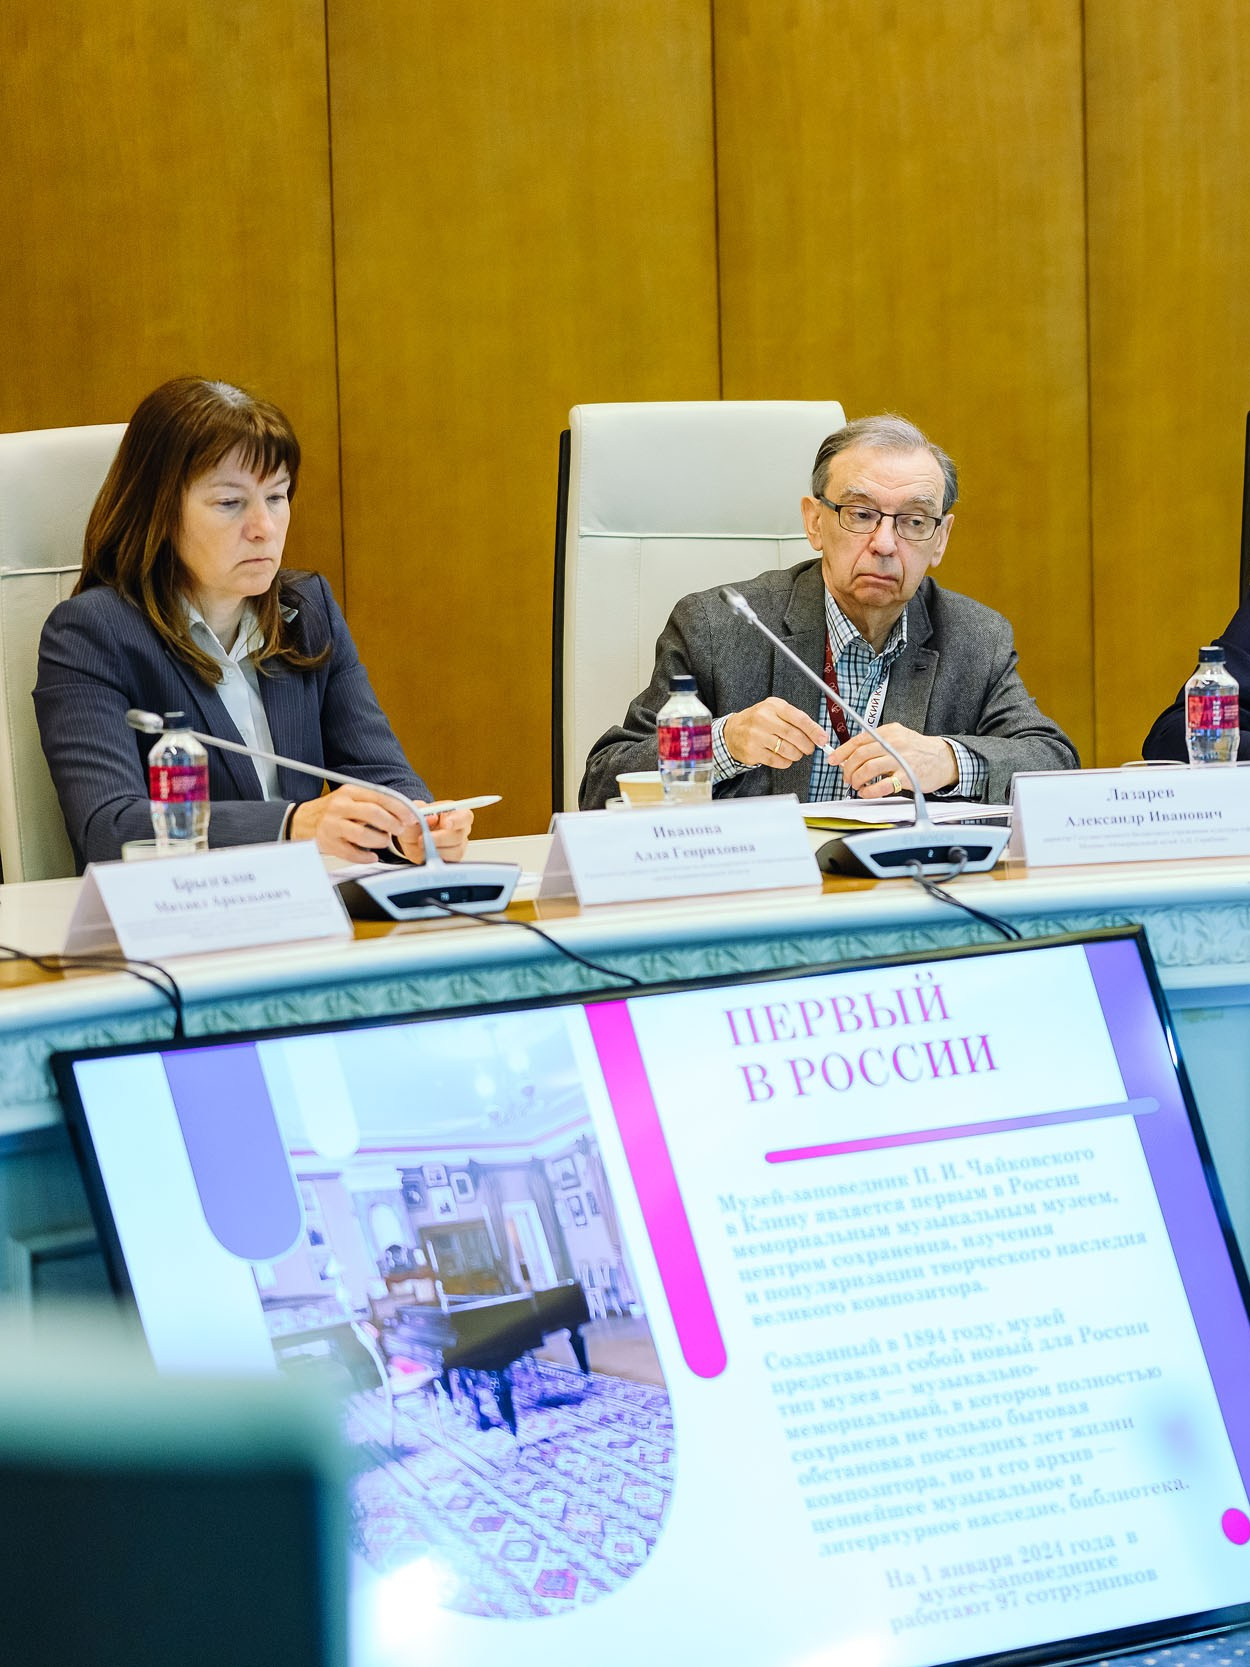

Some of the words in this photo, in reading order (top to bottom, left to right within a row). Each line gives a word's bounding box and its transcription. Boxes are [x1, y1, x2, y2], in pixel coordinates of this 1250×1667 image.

[1106, 787, 1176, 803] Лазарев
[1065, 811, 1145, 829] Александр
[1148, 809, 1223, 823] Иванович
[652, 825, 722, 839] Иванова
[634, 849, 670, 864] Алла
[724, 974, 951, 1045] ПЕРВЫЙ
[739, 1063, 776, 1104] В
[789, 1035, 997, 1096] РОССИИ
